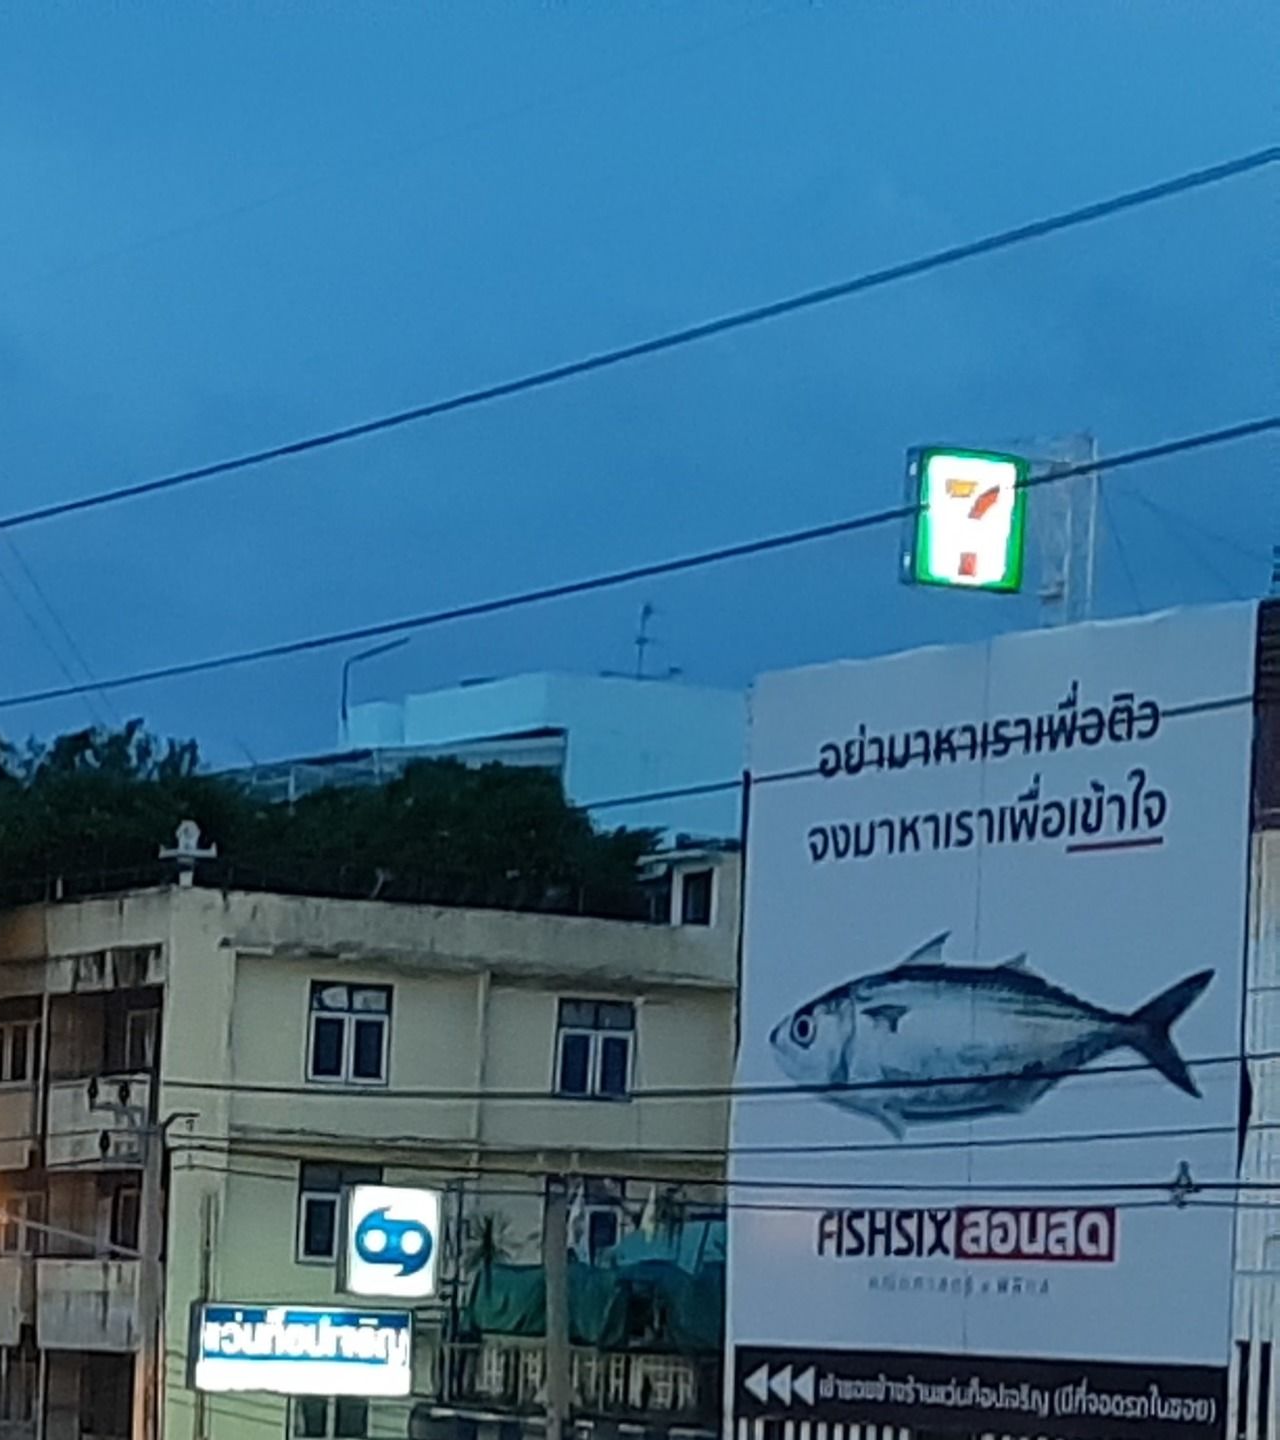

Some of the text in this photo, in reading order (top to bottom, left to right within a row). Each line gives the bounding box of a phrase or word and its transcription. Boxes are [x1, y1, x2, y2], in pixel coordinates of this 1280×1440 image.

[819, 680, 1160, 778] อย่ามาหาเราเพื่อติว
[808, 768, 1167, 862] จงมาหาเราเพื่อเข้าใจ
